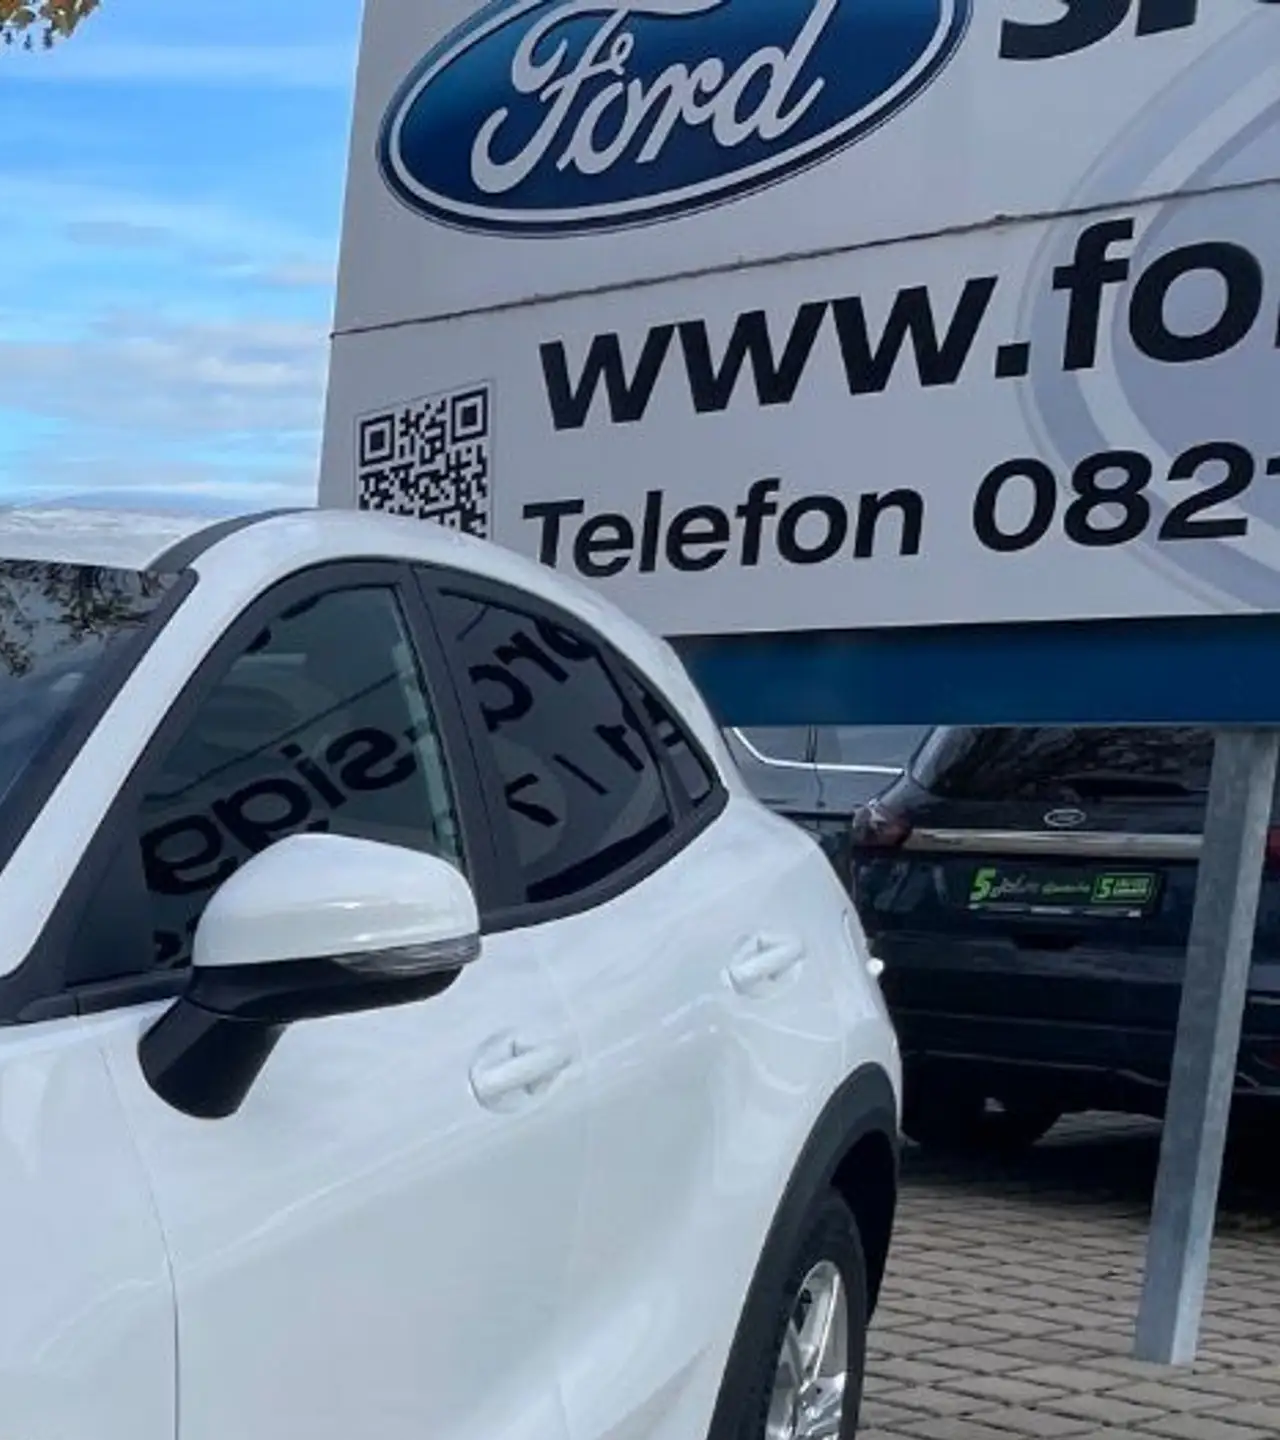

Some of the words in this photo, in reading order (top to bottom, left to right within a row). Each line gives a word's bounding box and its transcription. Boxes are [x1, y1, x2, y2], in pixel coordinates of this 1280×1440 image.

[470, 0, 825, 194] Ford
[540, 218, 1280, 431] www.fo
[522, 478, 925, 578] Telefon
[973, 441, 1280, 552] 082
